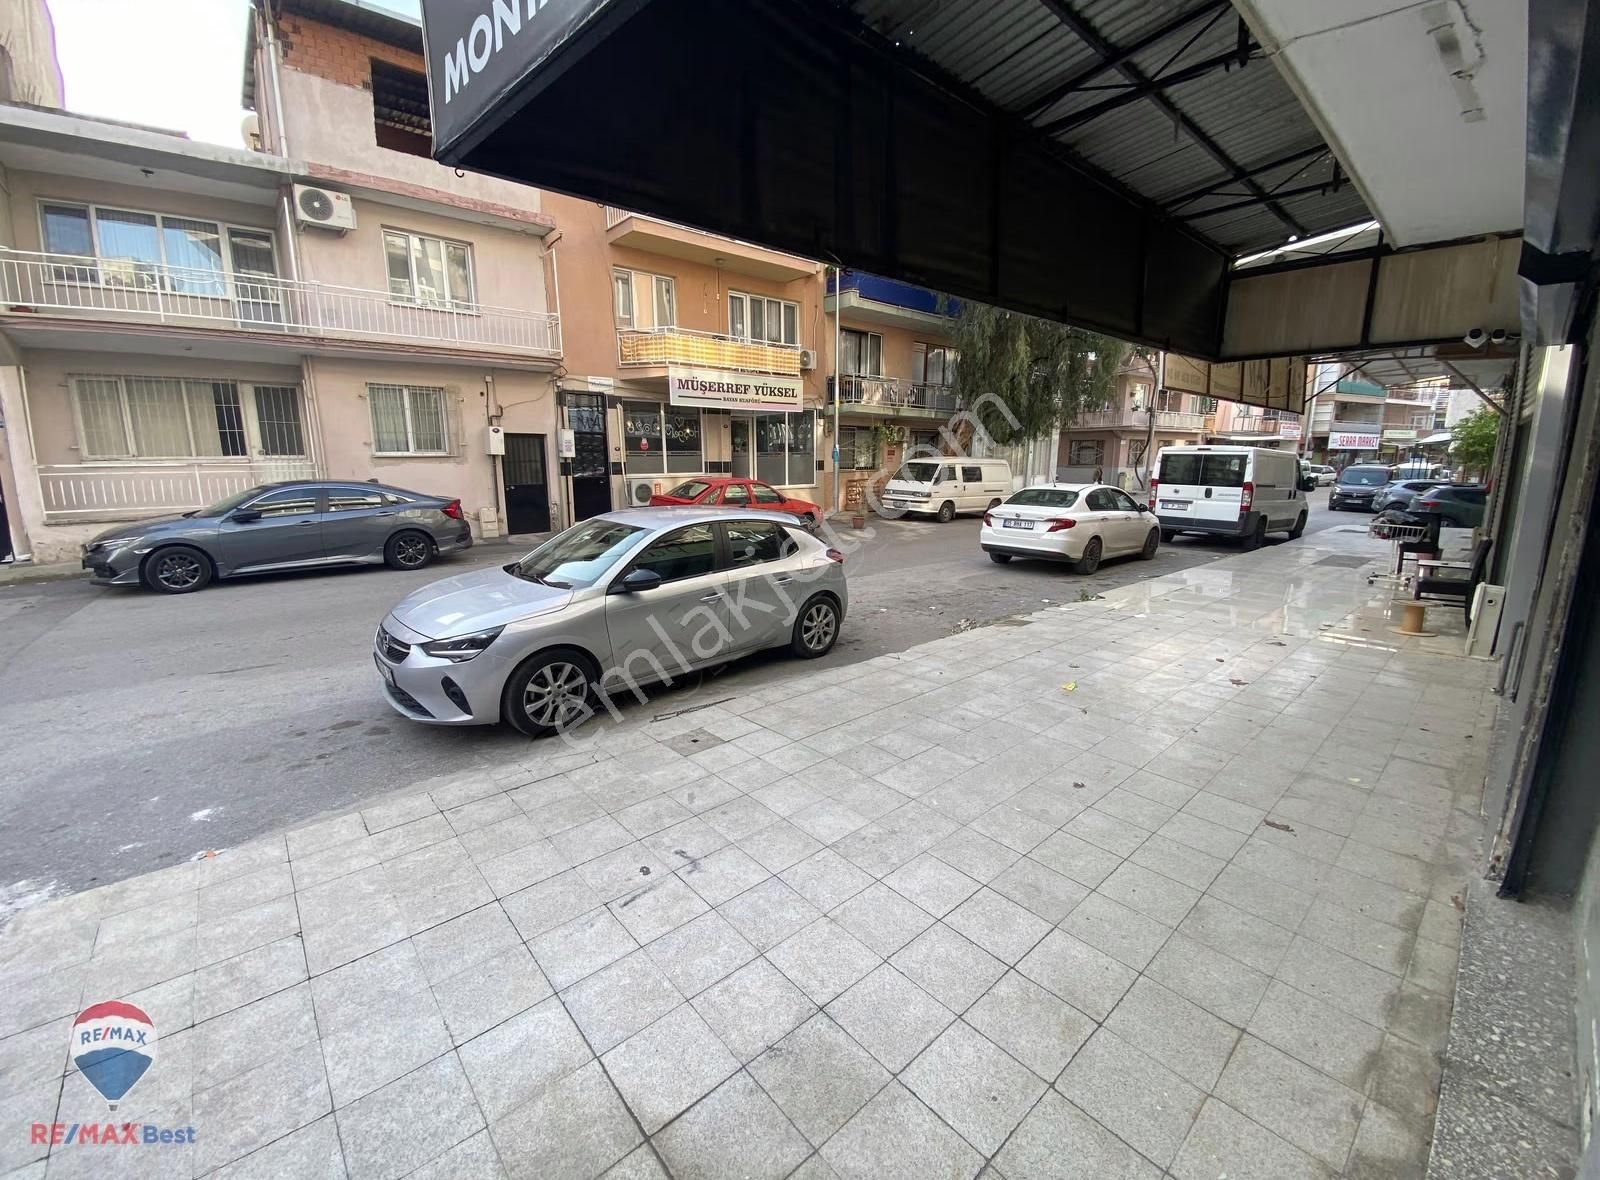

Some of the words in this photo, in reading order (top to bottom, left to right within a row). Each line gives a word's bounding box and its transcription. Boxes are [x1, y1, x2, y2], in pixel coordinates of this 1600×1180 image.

[444, 0, 551, 104] MON
[677, 376, 751, 395] MÜŞERREF
[754, 383, 798, 398] YÜKSEL
[1357, 436, 1379, 448] MARKET
